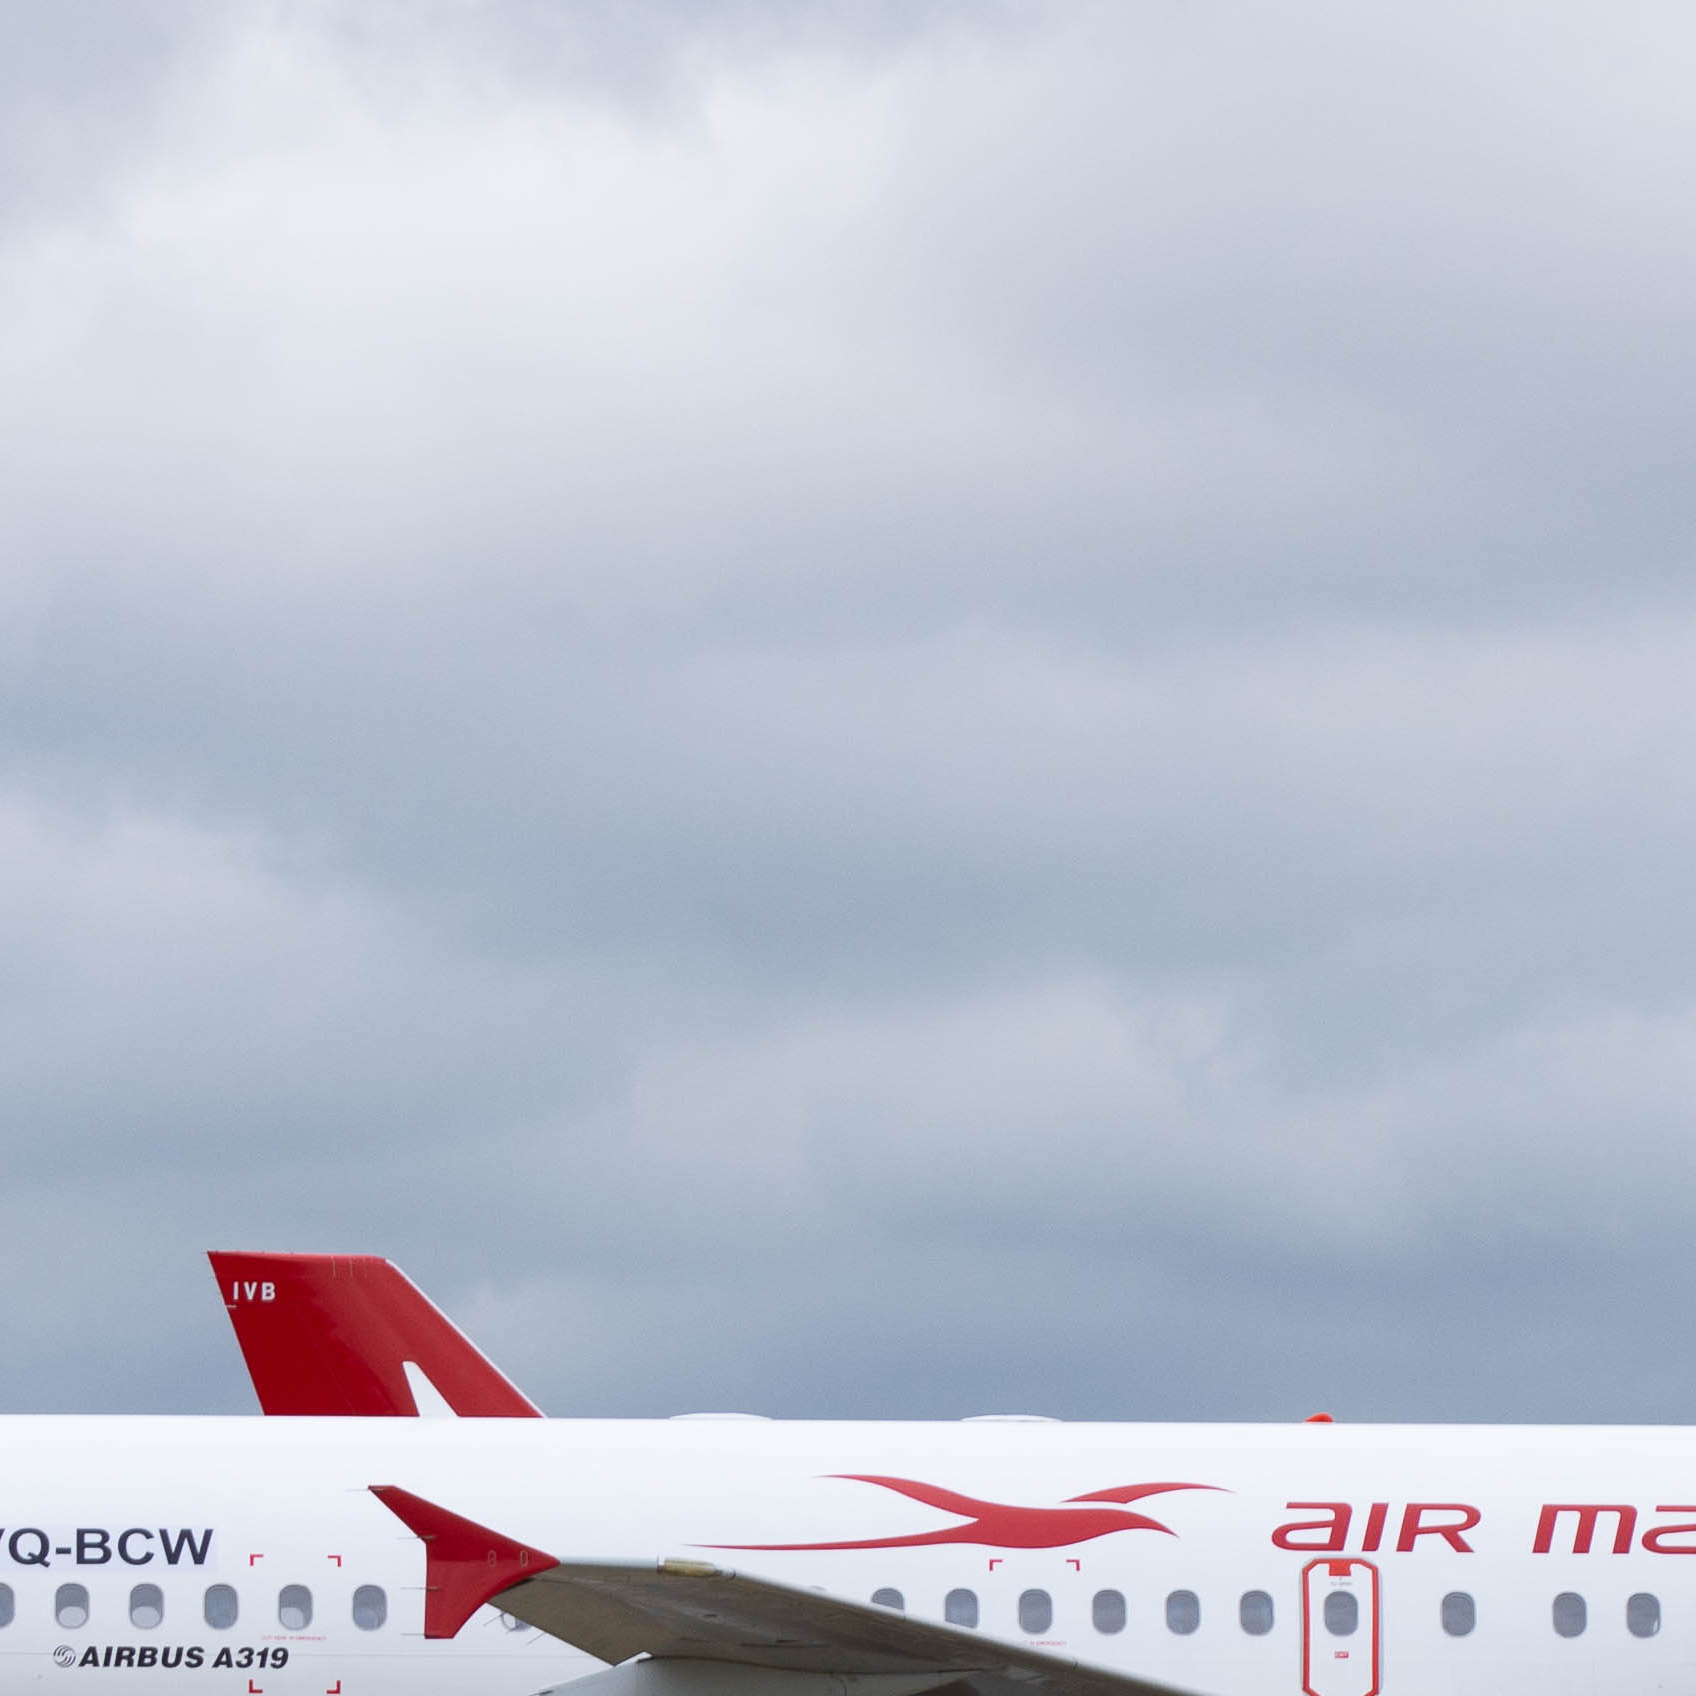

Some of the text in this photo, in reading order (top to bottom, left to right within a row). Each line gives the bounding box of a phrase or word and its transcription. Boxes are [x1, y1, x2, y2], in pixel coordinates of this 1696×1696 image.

[233, 1281, 276, 1301] IVB
[78, 1646, 289, 1669] AIRBUS A319
